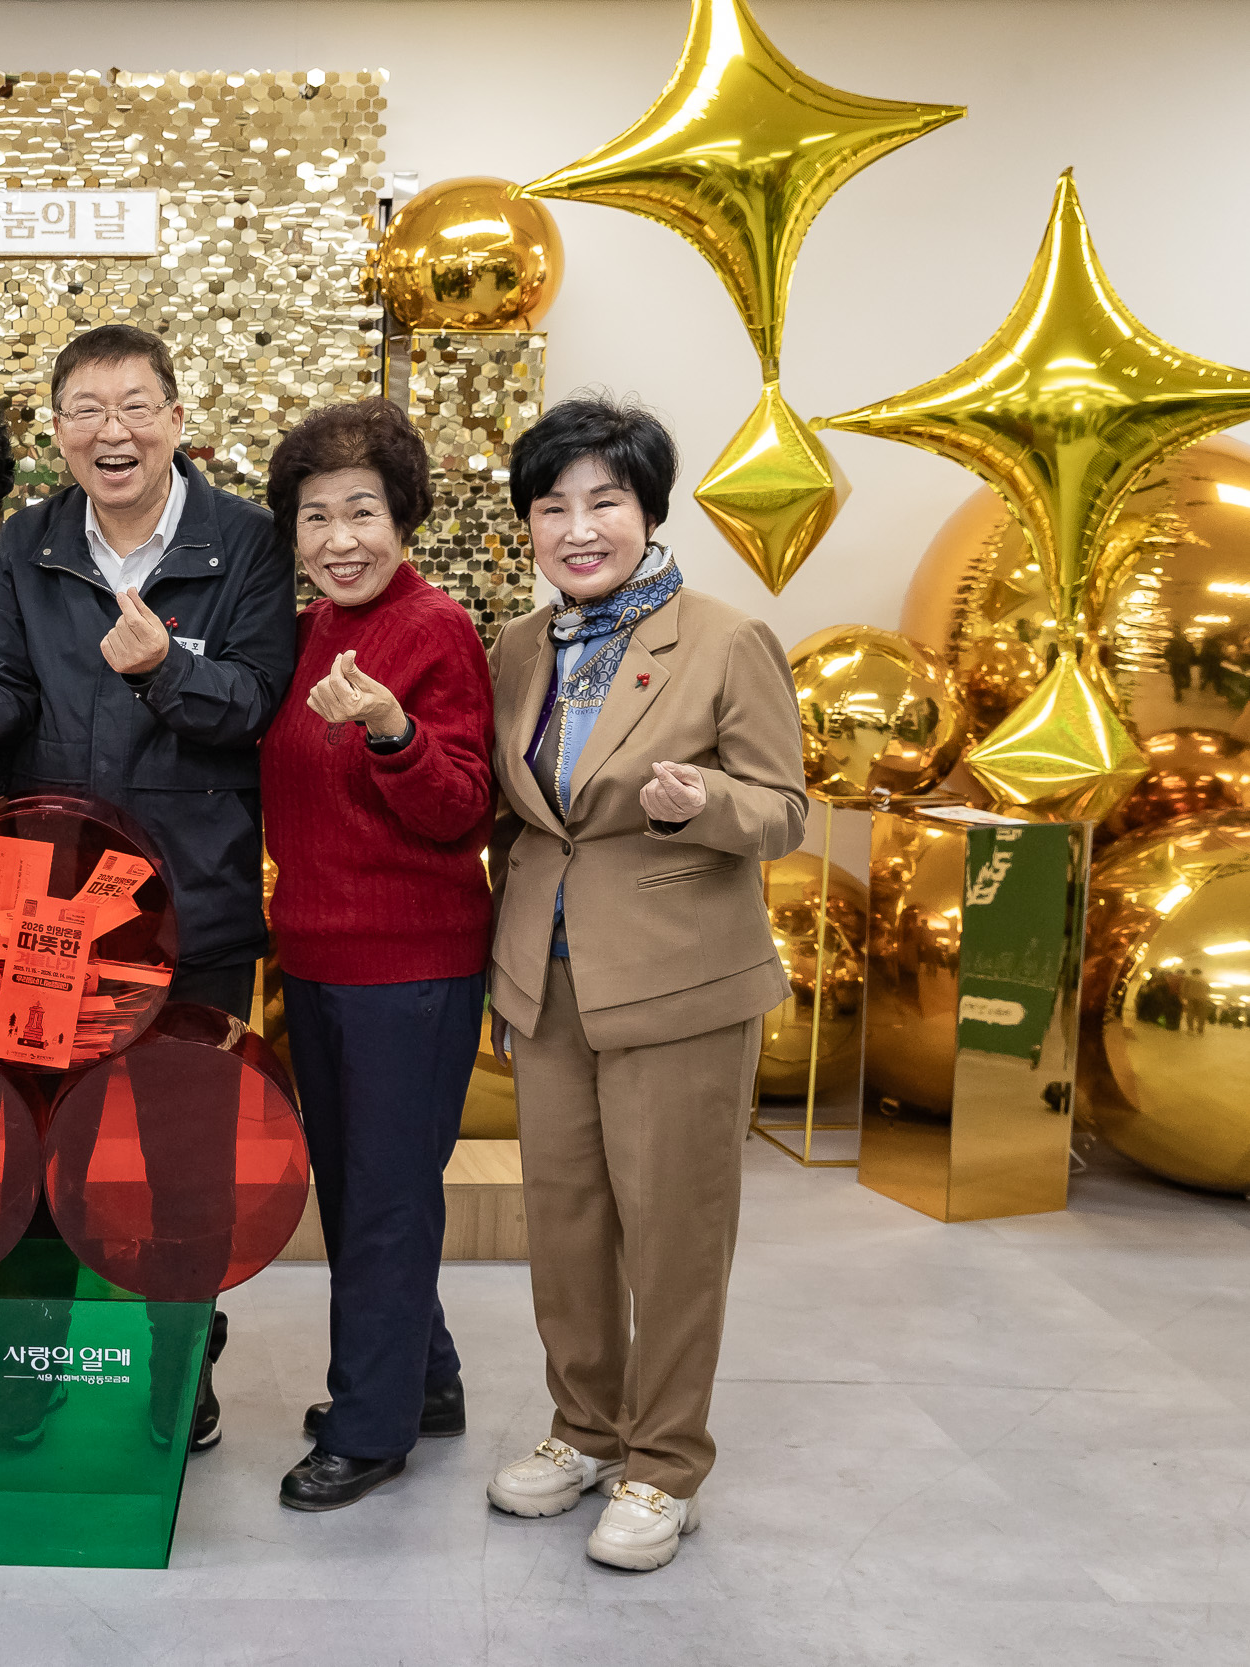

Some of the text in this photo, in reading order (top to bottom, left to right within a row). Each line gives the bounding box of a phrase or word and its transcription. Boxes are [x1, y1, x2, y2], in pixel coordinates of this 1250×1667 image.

[92, 201, 130, 240] 날
[21, 921, 44, 933] 2026
[17, 931, 81, 958] 따뜻한
[3, 1346, 131, 1371] 사랑의 열매
[36, 1373, 130, 1385] 서울 사회복지공동모금회
